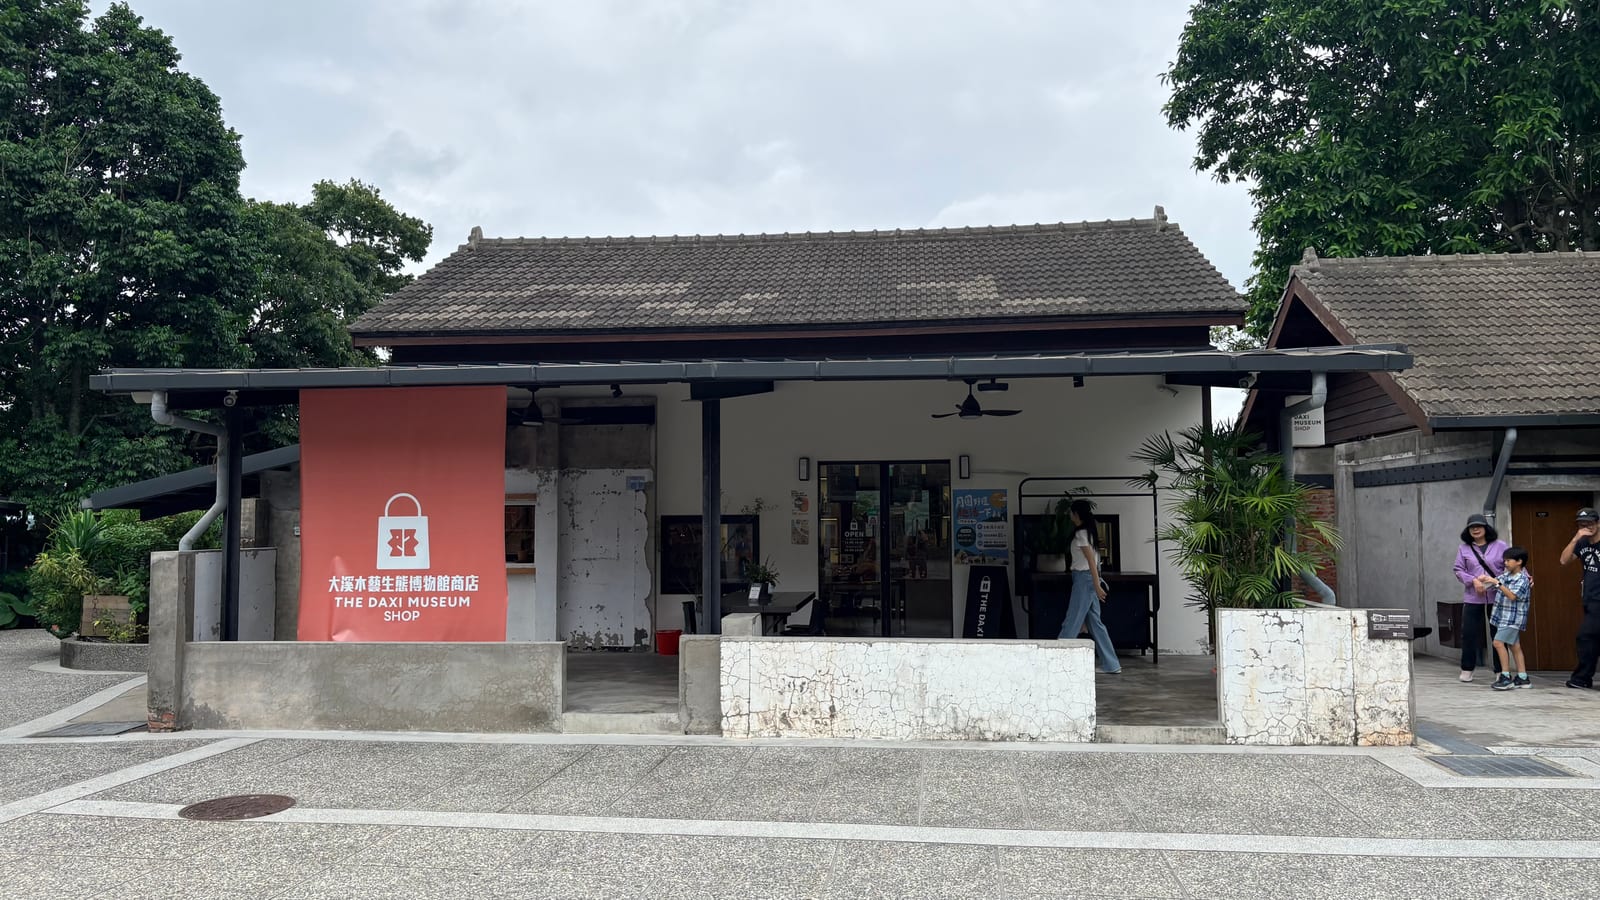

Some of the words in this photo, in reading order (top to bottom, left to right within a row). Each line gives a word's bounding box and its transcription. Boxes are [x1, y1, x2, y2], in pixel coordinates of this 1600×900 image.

[328, 575, 479, 593] 大溪木藝生態博物館商店
[334, 596, 363, 608] THE
[368, 596, 403, 608] DAXI
[408, 596, 470, 608] MUSEUM
[980, 593, 989, 612] THE
[384, 610, 420, 622] SHOP
[976, 614, 986, 637] DAXI
